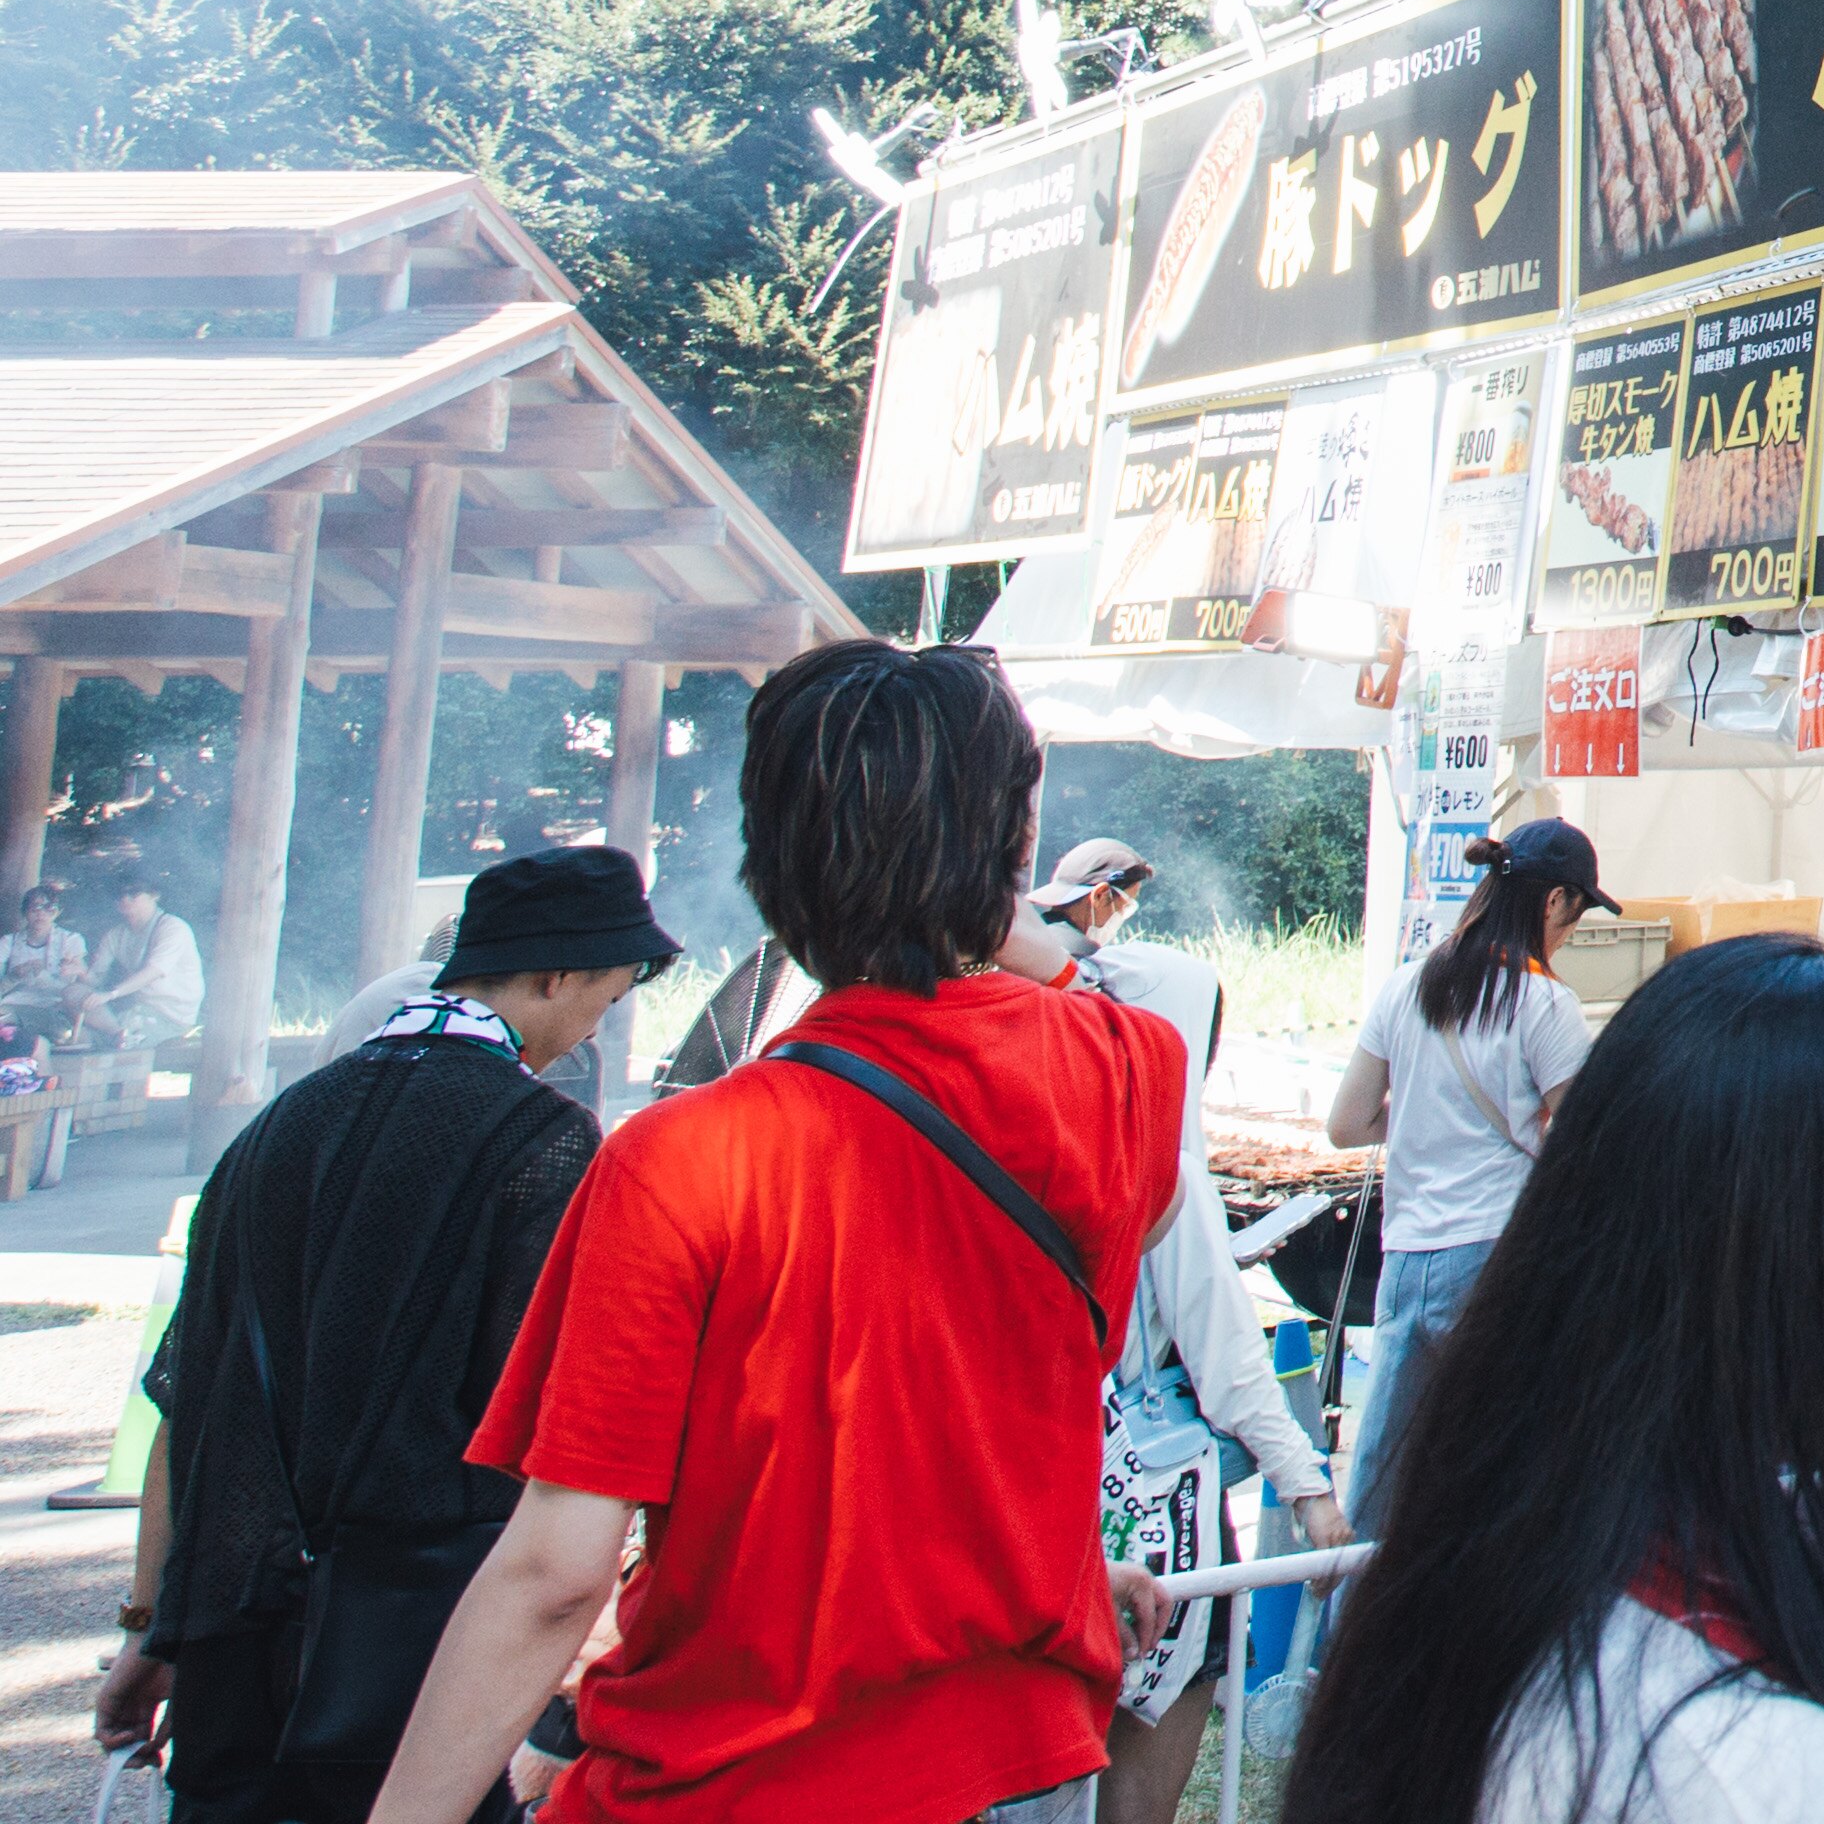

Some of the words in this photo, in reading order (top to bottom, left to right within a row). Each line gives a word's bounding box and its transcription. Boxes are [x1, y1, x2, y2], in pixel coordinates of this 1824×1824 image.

[1258, 69, 1538, 290] 豚ドッグ
[1456, 259, 1540, 306] 五浦ハム
[1728, 299, 1816, 340] 第4874412号
[1616, 332, 1680, 364] 第5640553号
[1741, 331, 1813, 364] 第5085201号
[952, 313, 1100, 456] ハム焼
[1567, 370, 1678, 425] 厚切スモーク
[1687, 366, 1805, 460] ハム焼
[1456, 428, 1495, 465] ¥800
[1579, 414, 1655, 465] 牛タン焼
[1187, 459, 1272, 525] ハム焼
[1467, 562, 1502, 597] ¥800
[1570, 565, 1655, 614] 1300円
[1711, 547, 1796, 600] 700円
[1549, 666, 1637, 714] ご注文口
[1445, 734, 1488, 769] ¥600
